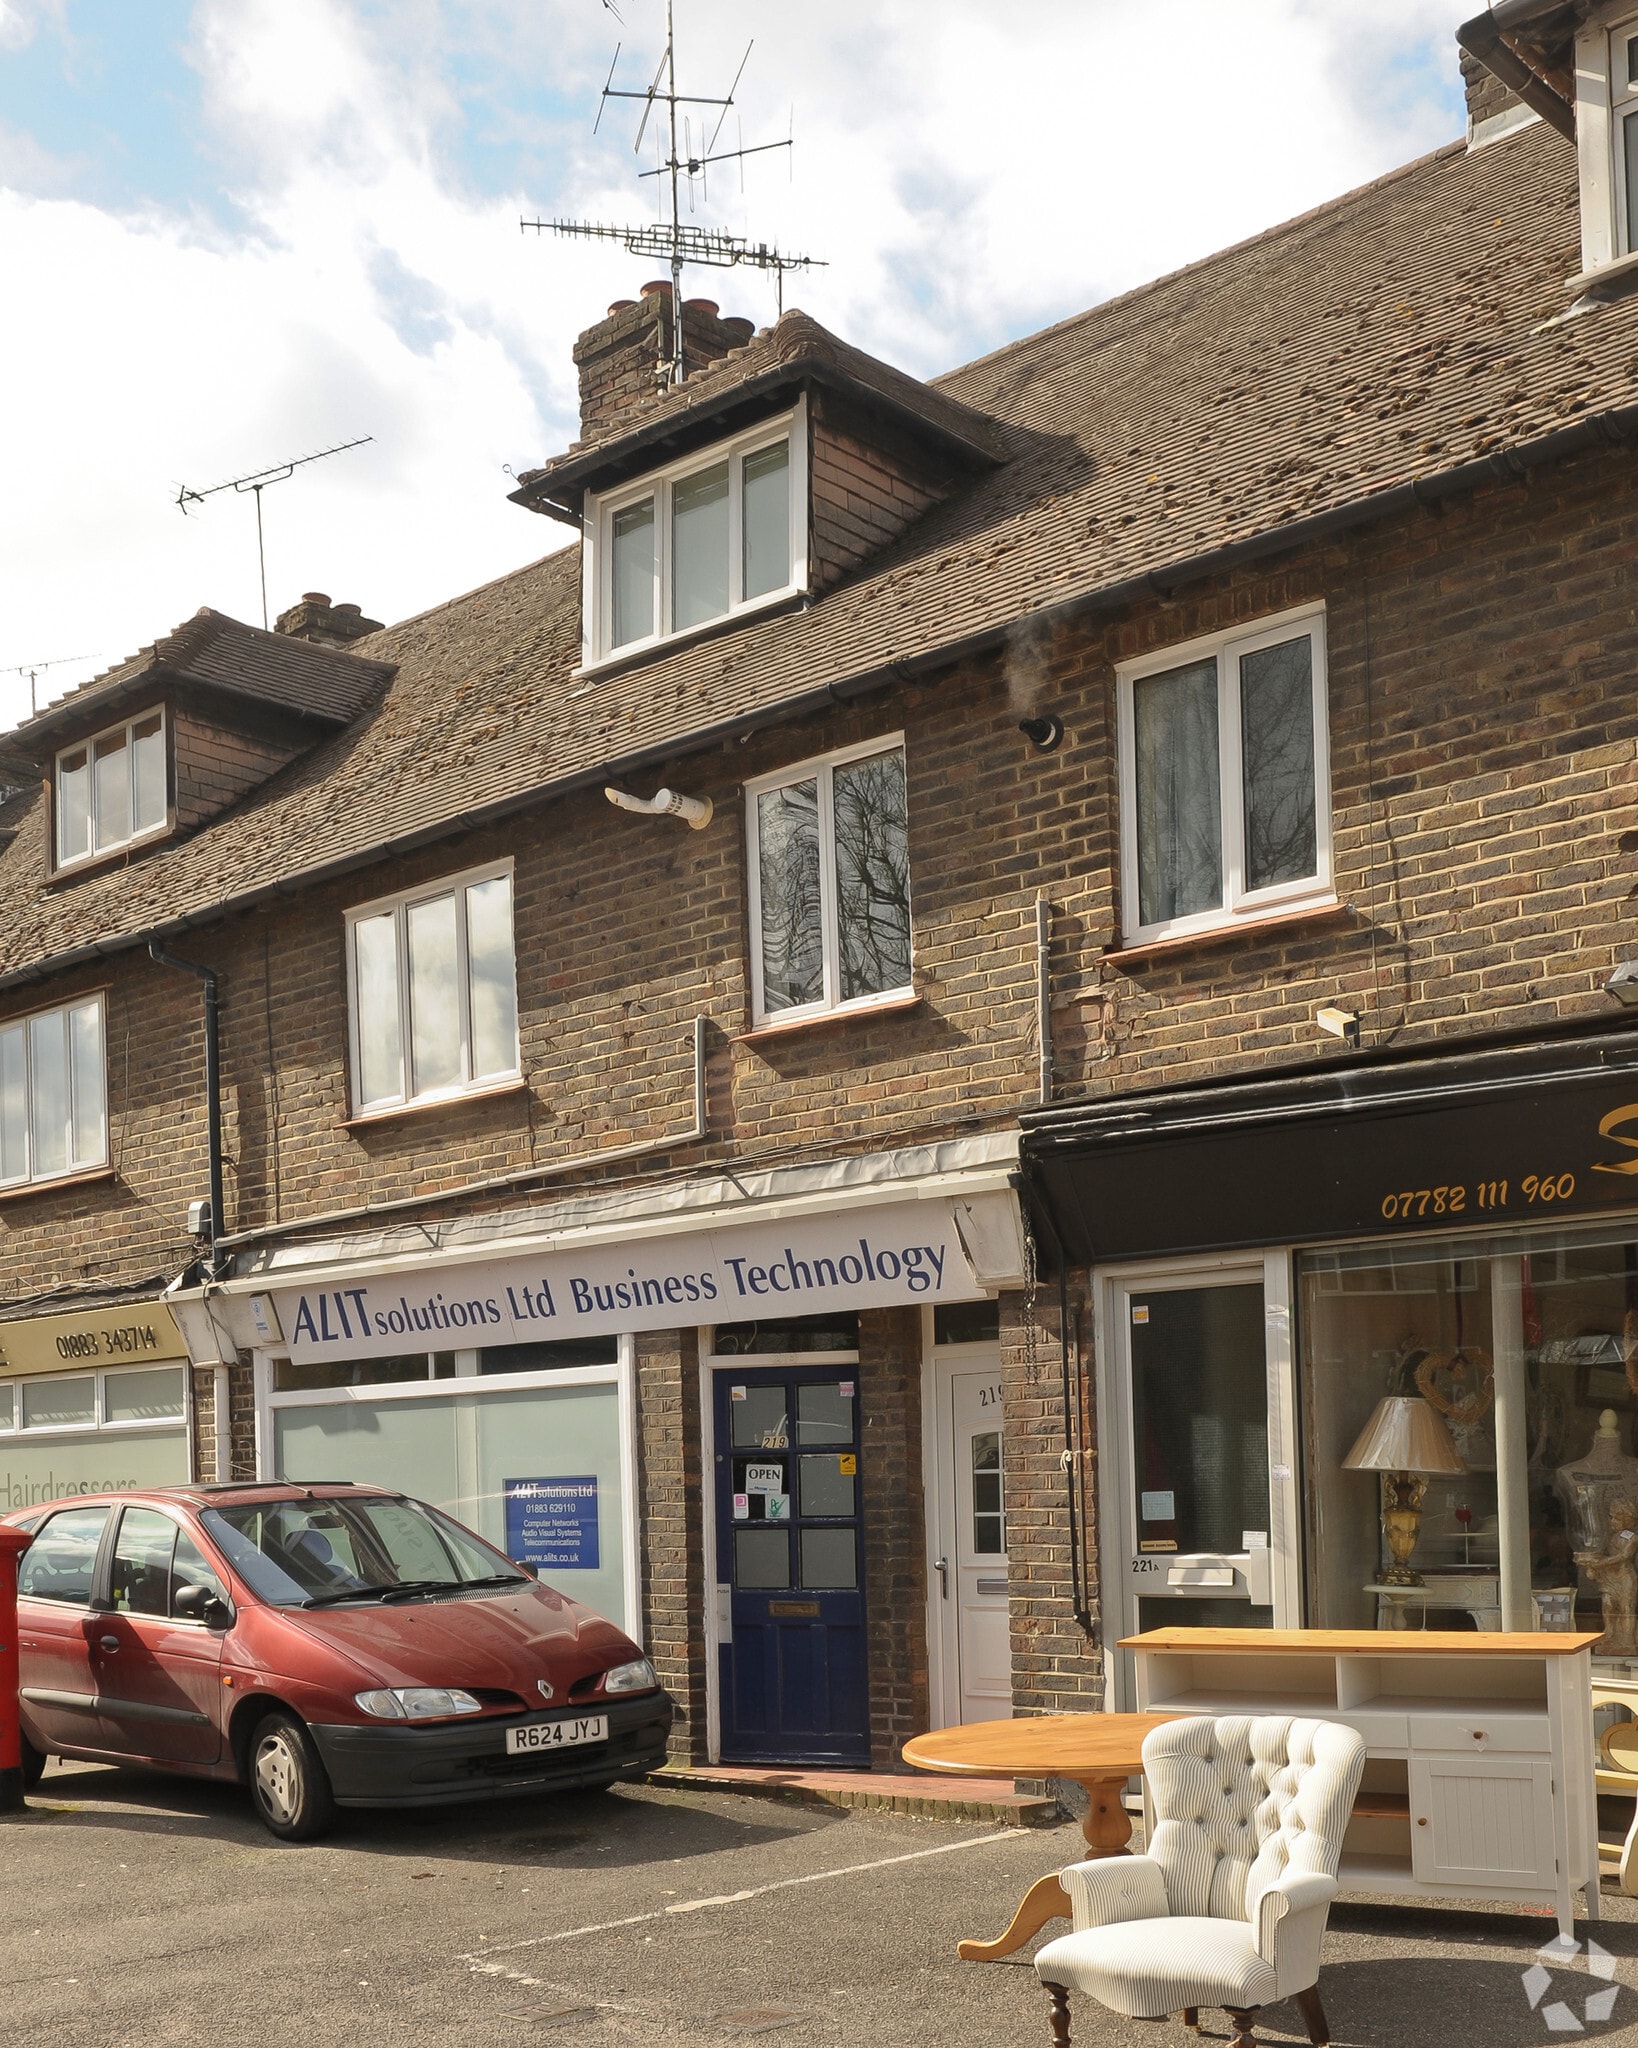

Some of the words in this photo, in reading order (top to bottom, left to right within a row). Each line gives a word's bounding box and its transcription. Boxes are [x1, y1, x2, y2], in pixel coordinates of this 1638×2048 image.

[1381, 1186, 1466, 1219] 07782
[1477, 1180, 1508, 1209] 111
[1521, 1173, 1576, 1203] 960
[506, 1279, 557, 1321] Ltd
[569, 1268, 718, 1314] Business
[723, 1238, 946, 1296] Technology
[56, 1332, 99, 1359] 01883
[101, 1325, 157, 1354] 343714
[763, 1437, 786, 1448] 219
[748, 1468, 780, 1480] OPEN
[578, 1485, 593, 1497] Ltd
[526, 1504, 548, 1513] 01883
[549, 1503, 576, 1513] 629110
[523, 1520, 551, 1528] Computer
[552, 1519, 579, 1527] Networks
[539, 1529, 556, 1537] Visual
[557, 1529, 582, 1538] Systems
[525, 1553, 579, 1562] www.alits.co.uk
[515, 1725, 563, 1748] R624
[569, 1719, 601, 1741] JYJ
